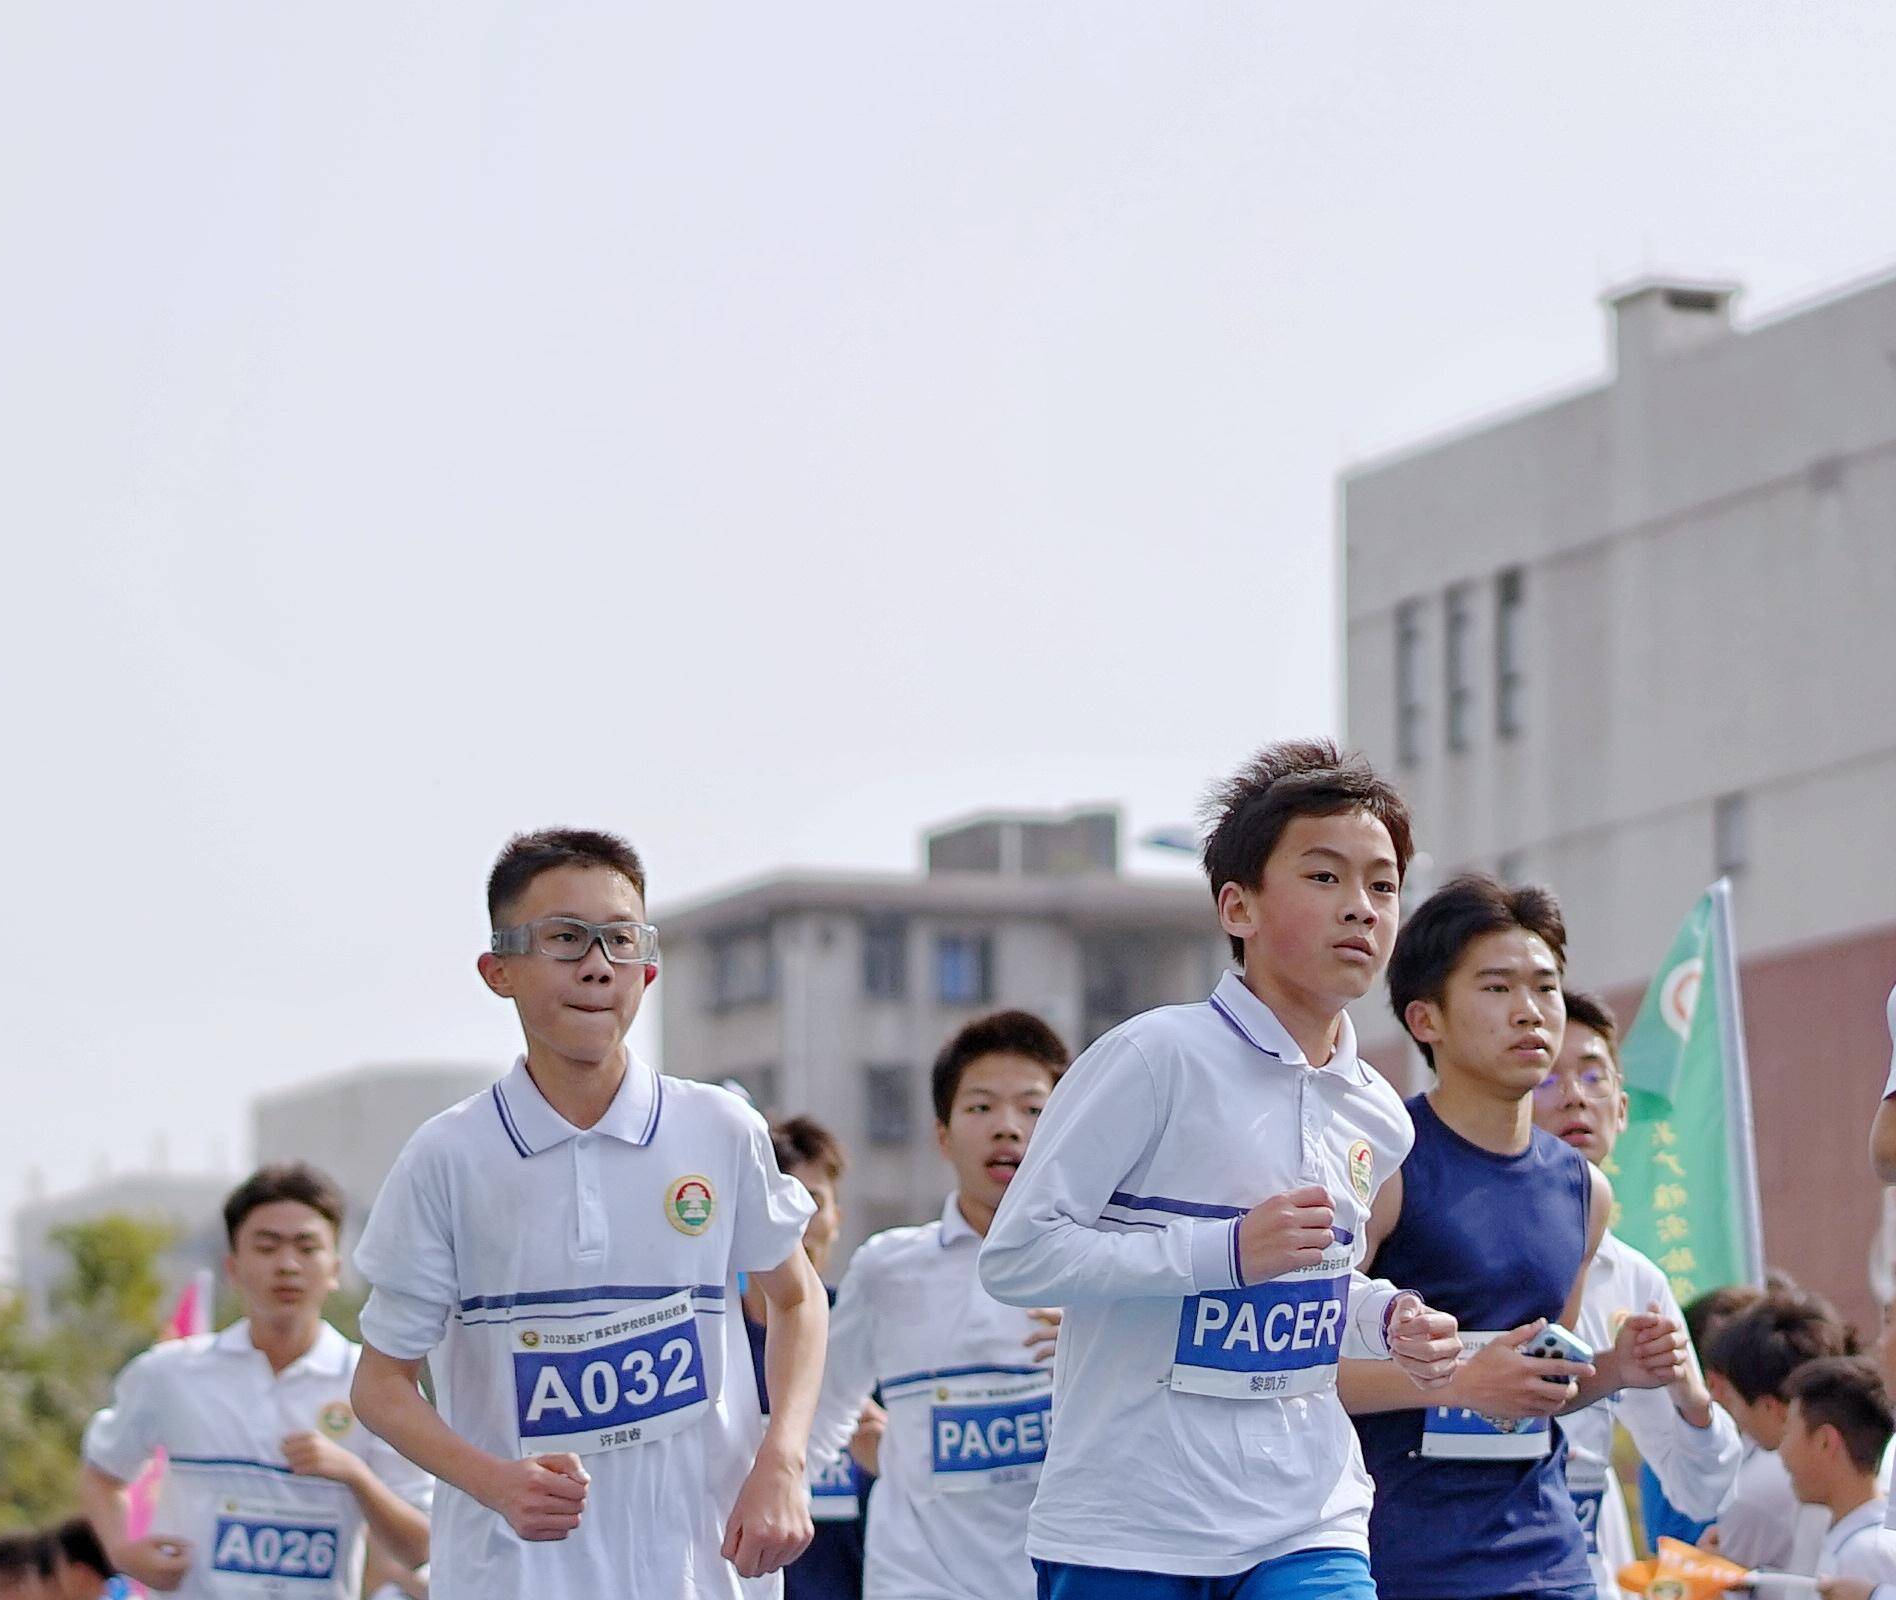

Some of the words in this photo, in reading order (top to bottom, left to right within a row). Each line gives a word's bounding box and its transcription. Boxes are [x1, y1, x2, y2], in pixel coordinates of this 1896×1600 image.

[1193, 1296, 1342, 1352] PACER
[526, 1338, 698, 1421] A032
[216, 1523, 336, 1572] A026
